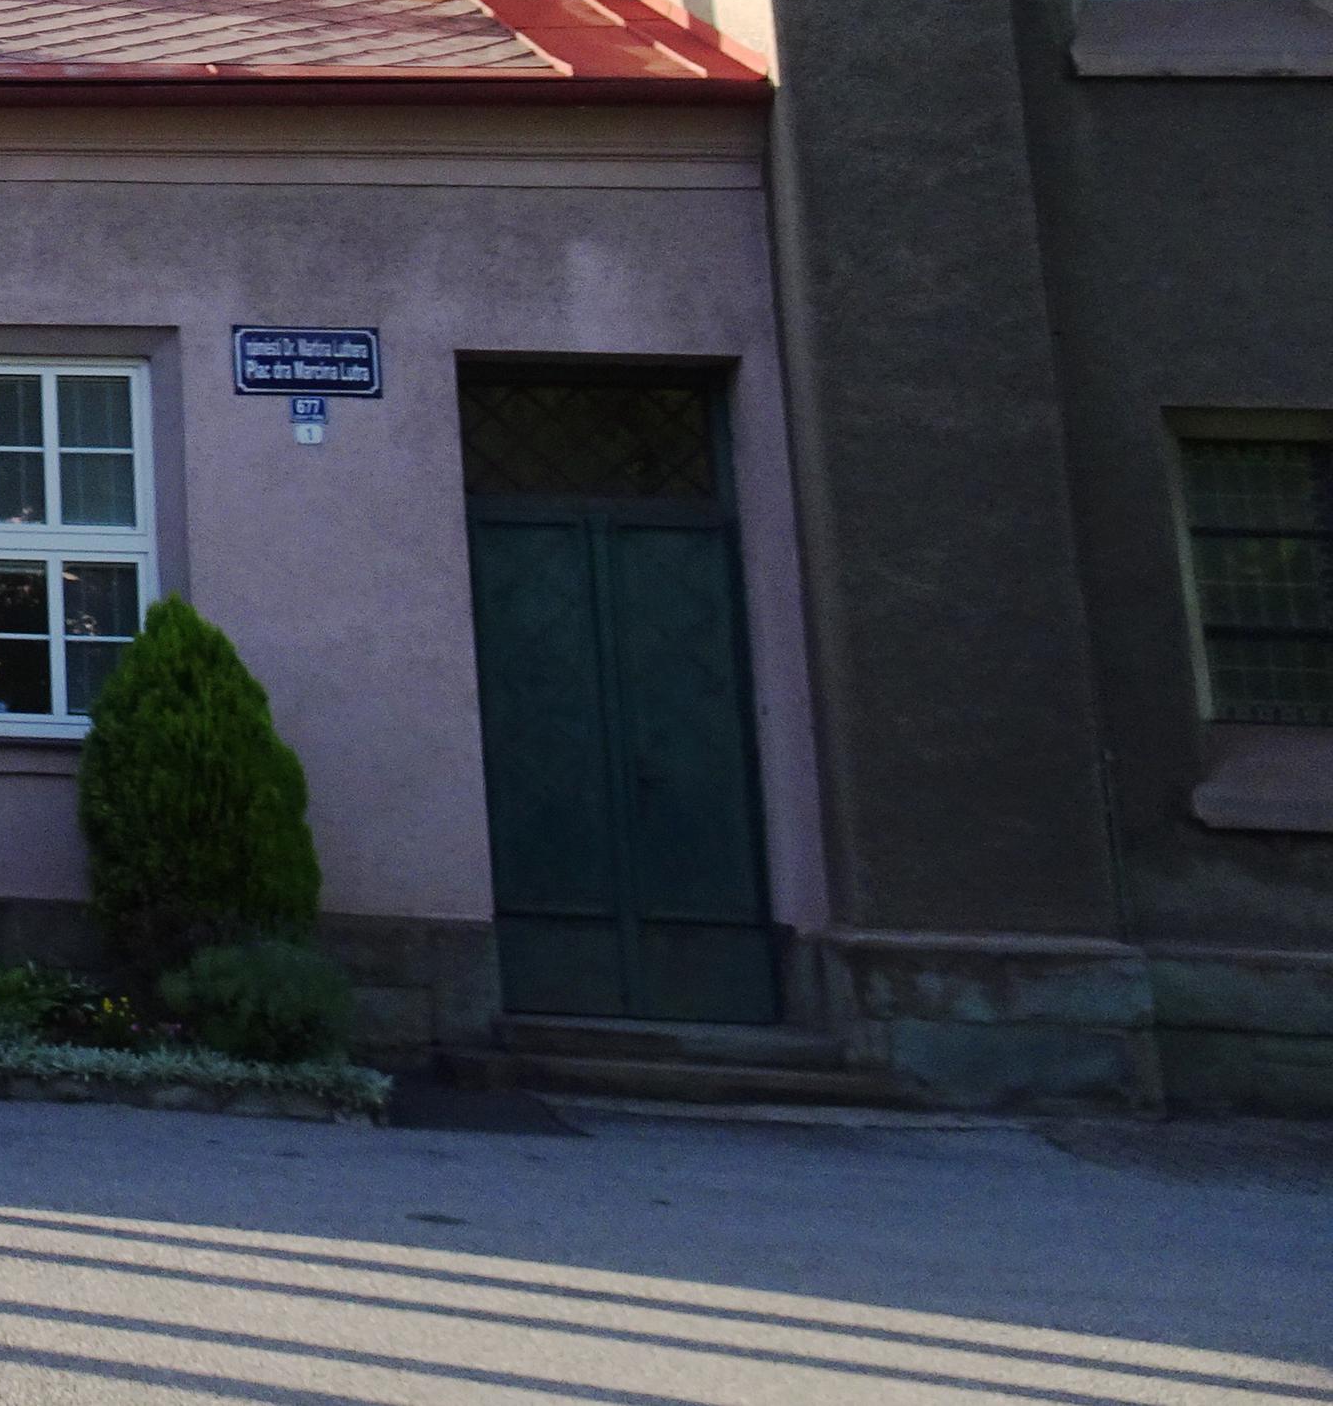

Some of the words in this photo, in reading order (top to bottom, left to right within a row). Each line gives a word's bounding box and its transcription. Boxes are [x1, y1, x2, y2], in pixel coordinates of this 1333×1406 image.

[245, 360, 271, 379] Plac
[293, 360, 338, 380] Marcina
[339, 361, 370, 381] Lutra
[295, 399, 321, 414] 677
